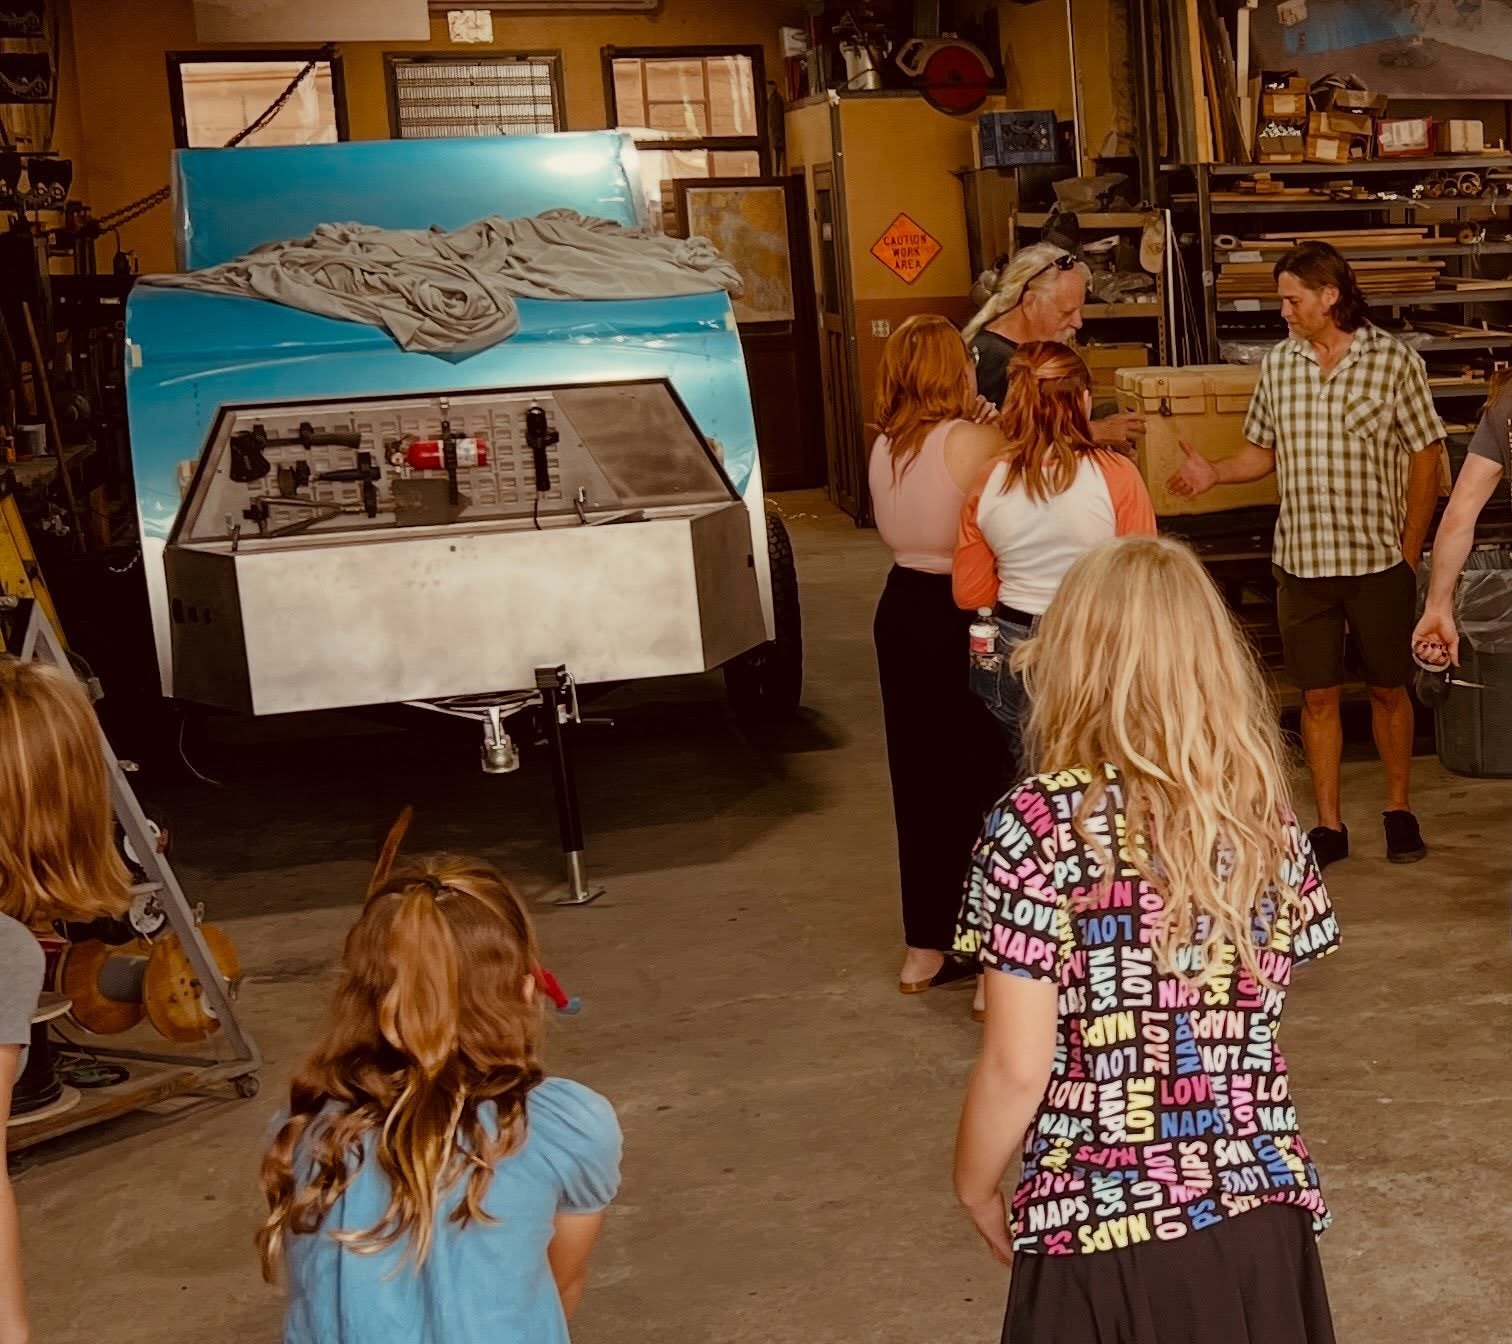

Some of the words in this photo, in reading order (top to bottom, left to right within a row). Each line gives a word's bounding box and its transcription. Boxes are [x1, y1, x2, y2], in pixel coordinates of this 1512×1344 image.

[883, 235, 927, 246] CAUTION
[892, 246, 921, 257] WORK
[895, 259, 921, 269] AREA
[992, 923, 1057, 972] NAPS
[1088, 946, 1119, 1011] NAPS
[1121, 945, 1153, 1007] LOVE
[1141, 1010, 1170, 1075] LOVE
[1175, 1012, 1202, 1075] NAPS
[1190, 1010, 1244, 1039] NAPS
[1243, 1012, 1272, 1072] LOVE
[1047, 1079, 1097, 1112] LOVE
[1098, 1079, 1127, 1145] NAPS
[1125, 1076, 1155, 1143] LOVE
[1231, 1073, 1259, 1137] LOVE
[1039, 1112, 1095, 1143] NAPS
[1161, 1109, 1224, 1139] NAPS
[1028, 1196, 1090, 1233] NAPS
[1078, 1212, 1151, 1254] NAPS
